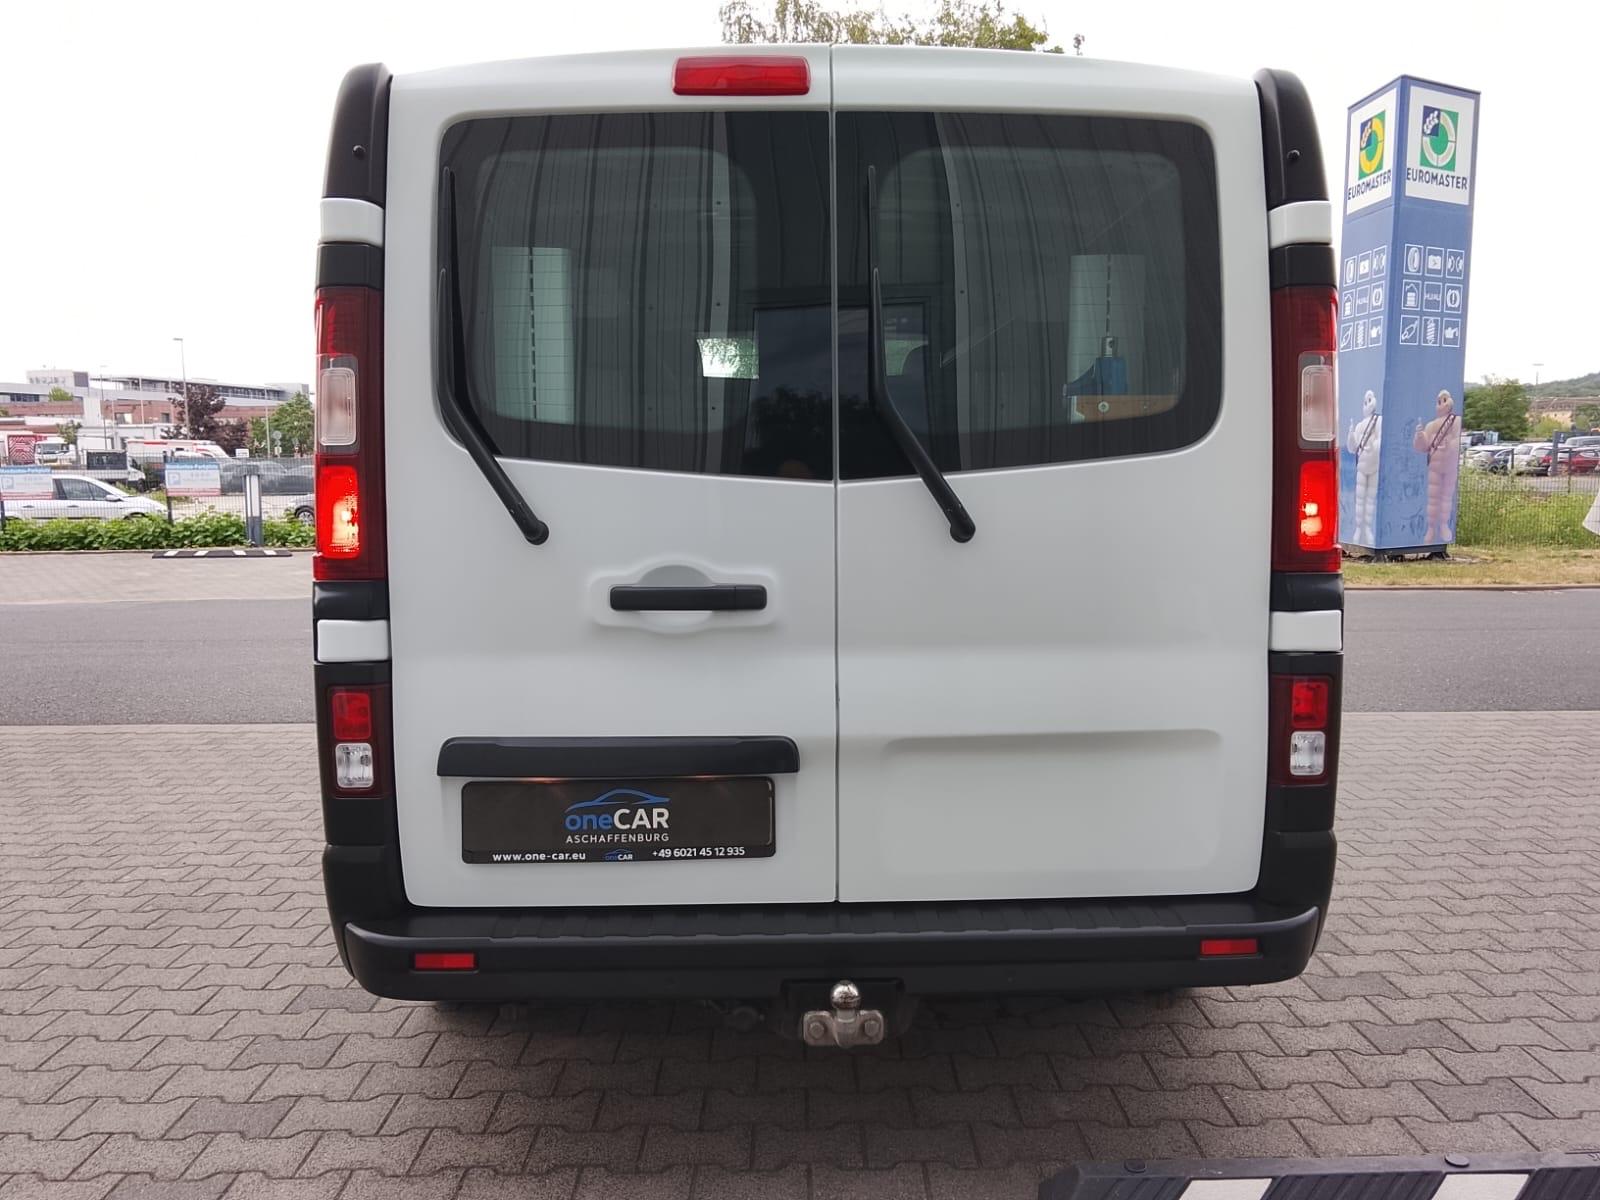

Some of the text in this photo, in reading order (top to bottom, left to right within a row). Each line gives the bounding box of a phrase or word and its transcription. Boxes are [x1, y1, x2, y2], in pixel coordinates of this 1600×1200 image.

[1347, 169, 1392, 200] EUROMASTER
[1406, 167, 1468, 190] EUROMASTER
[565, 807, 670, 830] oneCAR
[565, 833, 669, 844] ASCHAFFENBURG
[492, 852, 586, 861] www.one-car.eu
[652, 846, 745, 858] +49 6021 45 12 935
